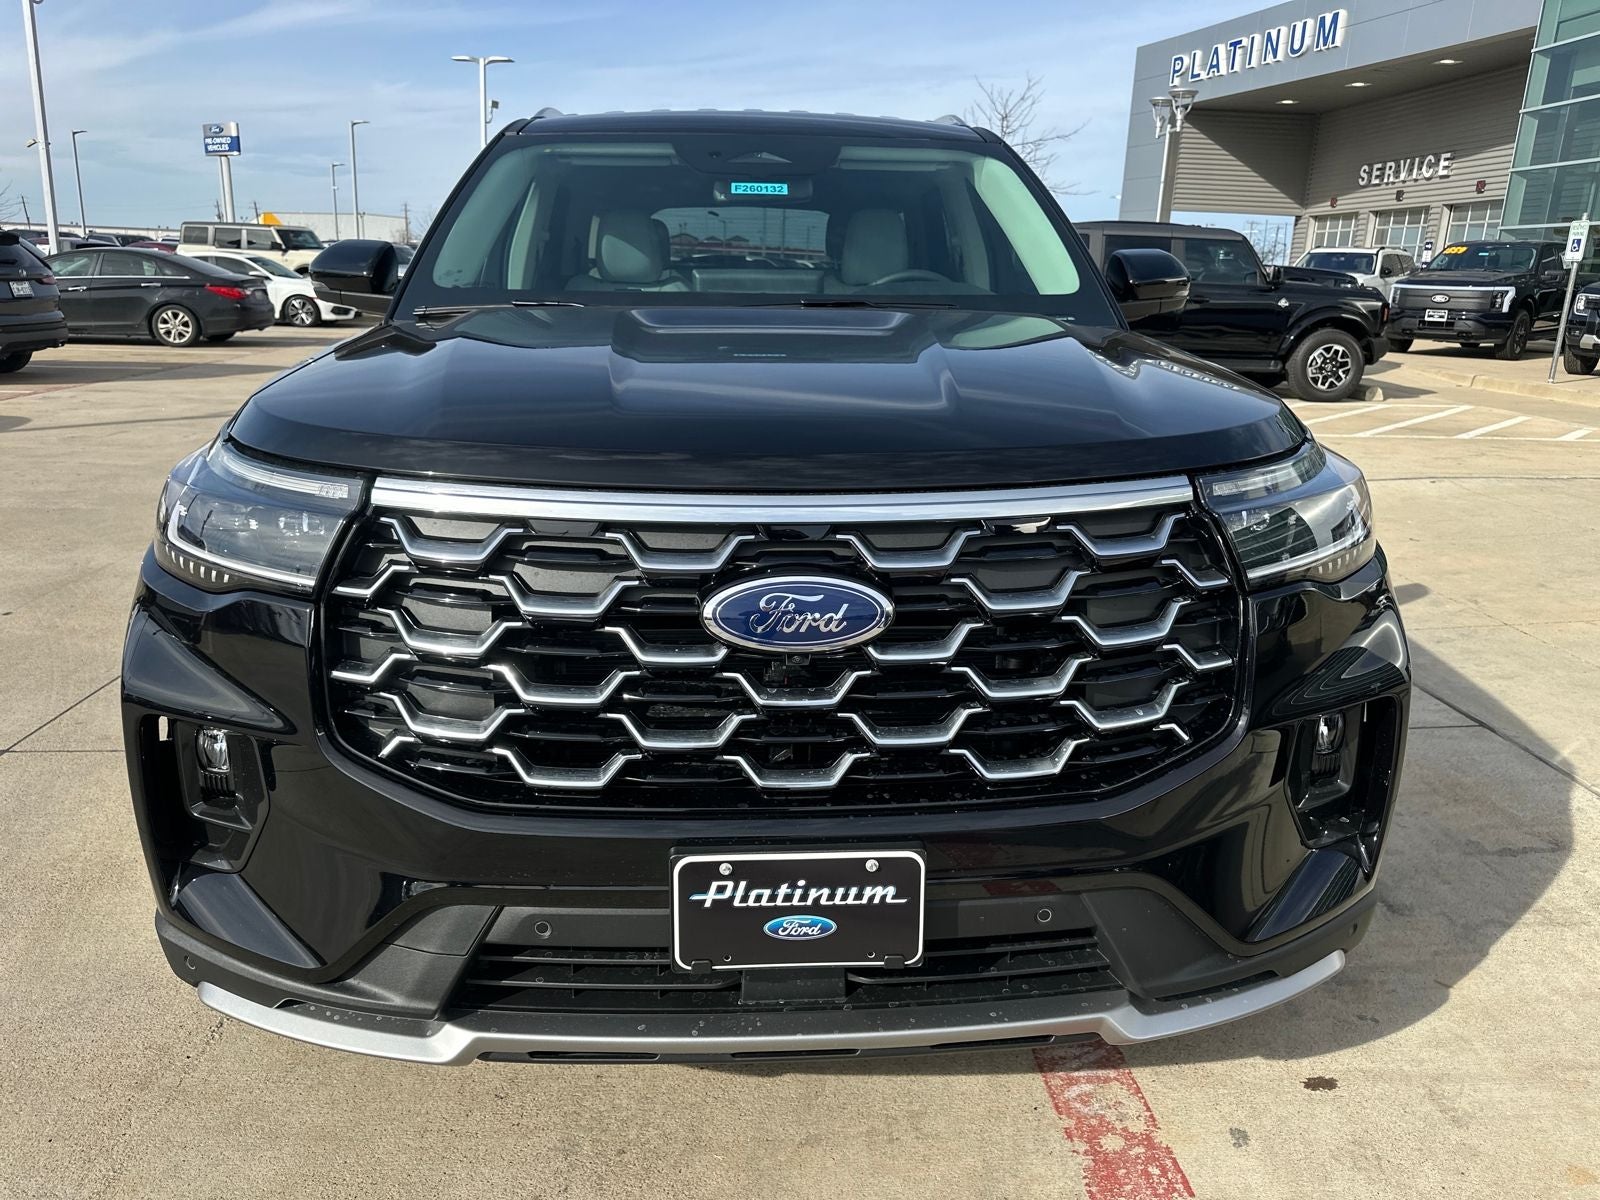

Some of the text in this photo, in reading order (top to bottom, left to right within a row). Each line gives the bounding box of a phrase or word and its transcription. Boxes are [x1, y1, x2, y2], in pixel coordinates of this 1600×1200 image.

[1169, 9, 1347, 86] PLATINUM
[1359, 153, 1451, 185] SERVICE
[734, 184, 784, 193] F260132
[750, 592, 849, 633] Ford
[689, 880, 908, 908] Platinum
[778, 919, 821, 936] Ford
